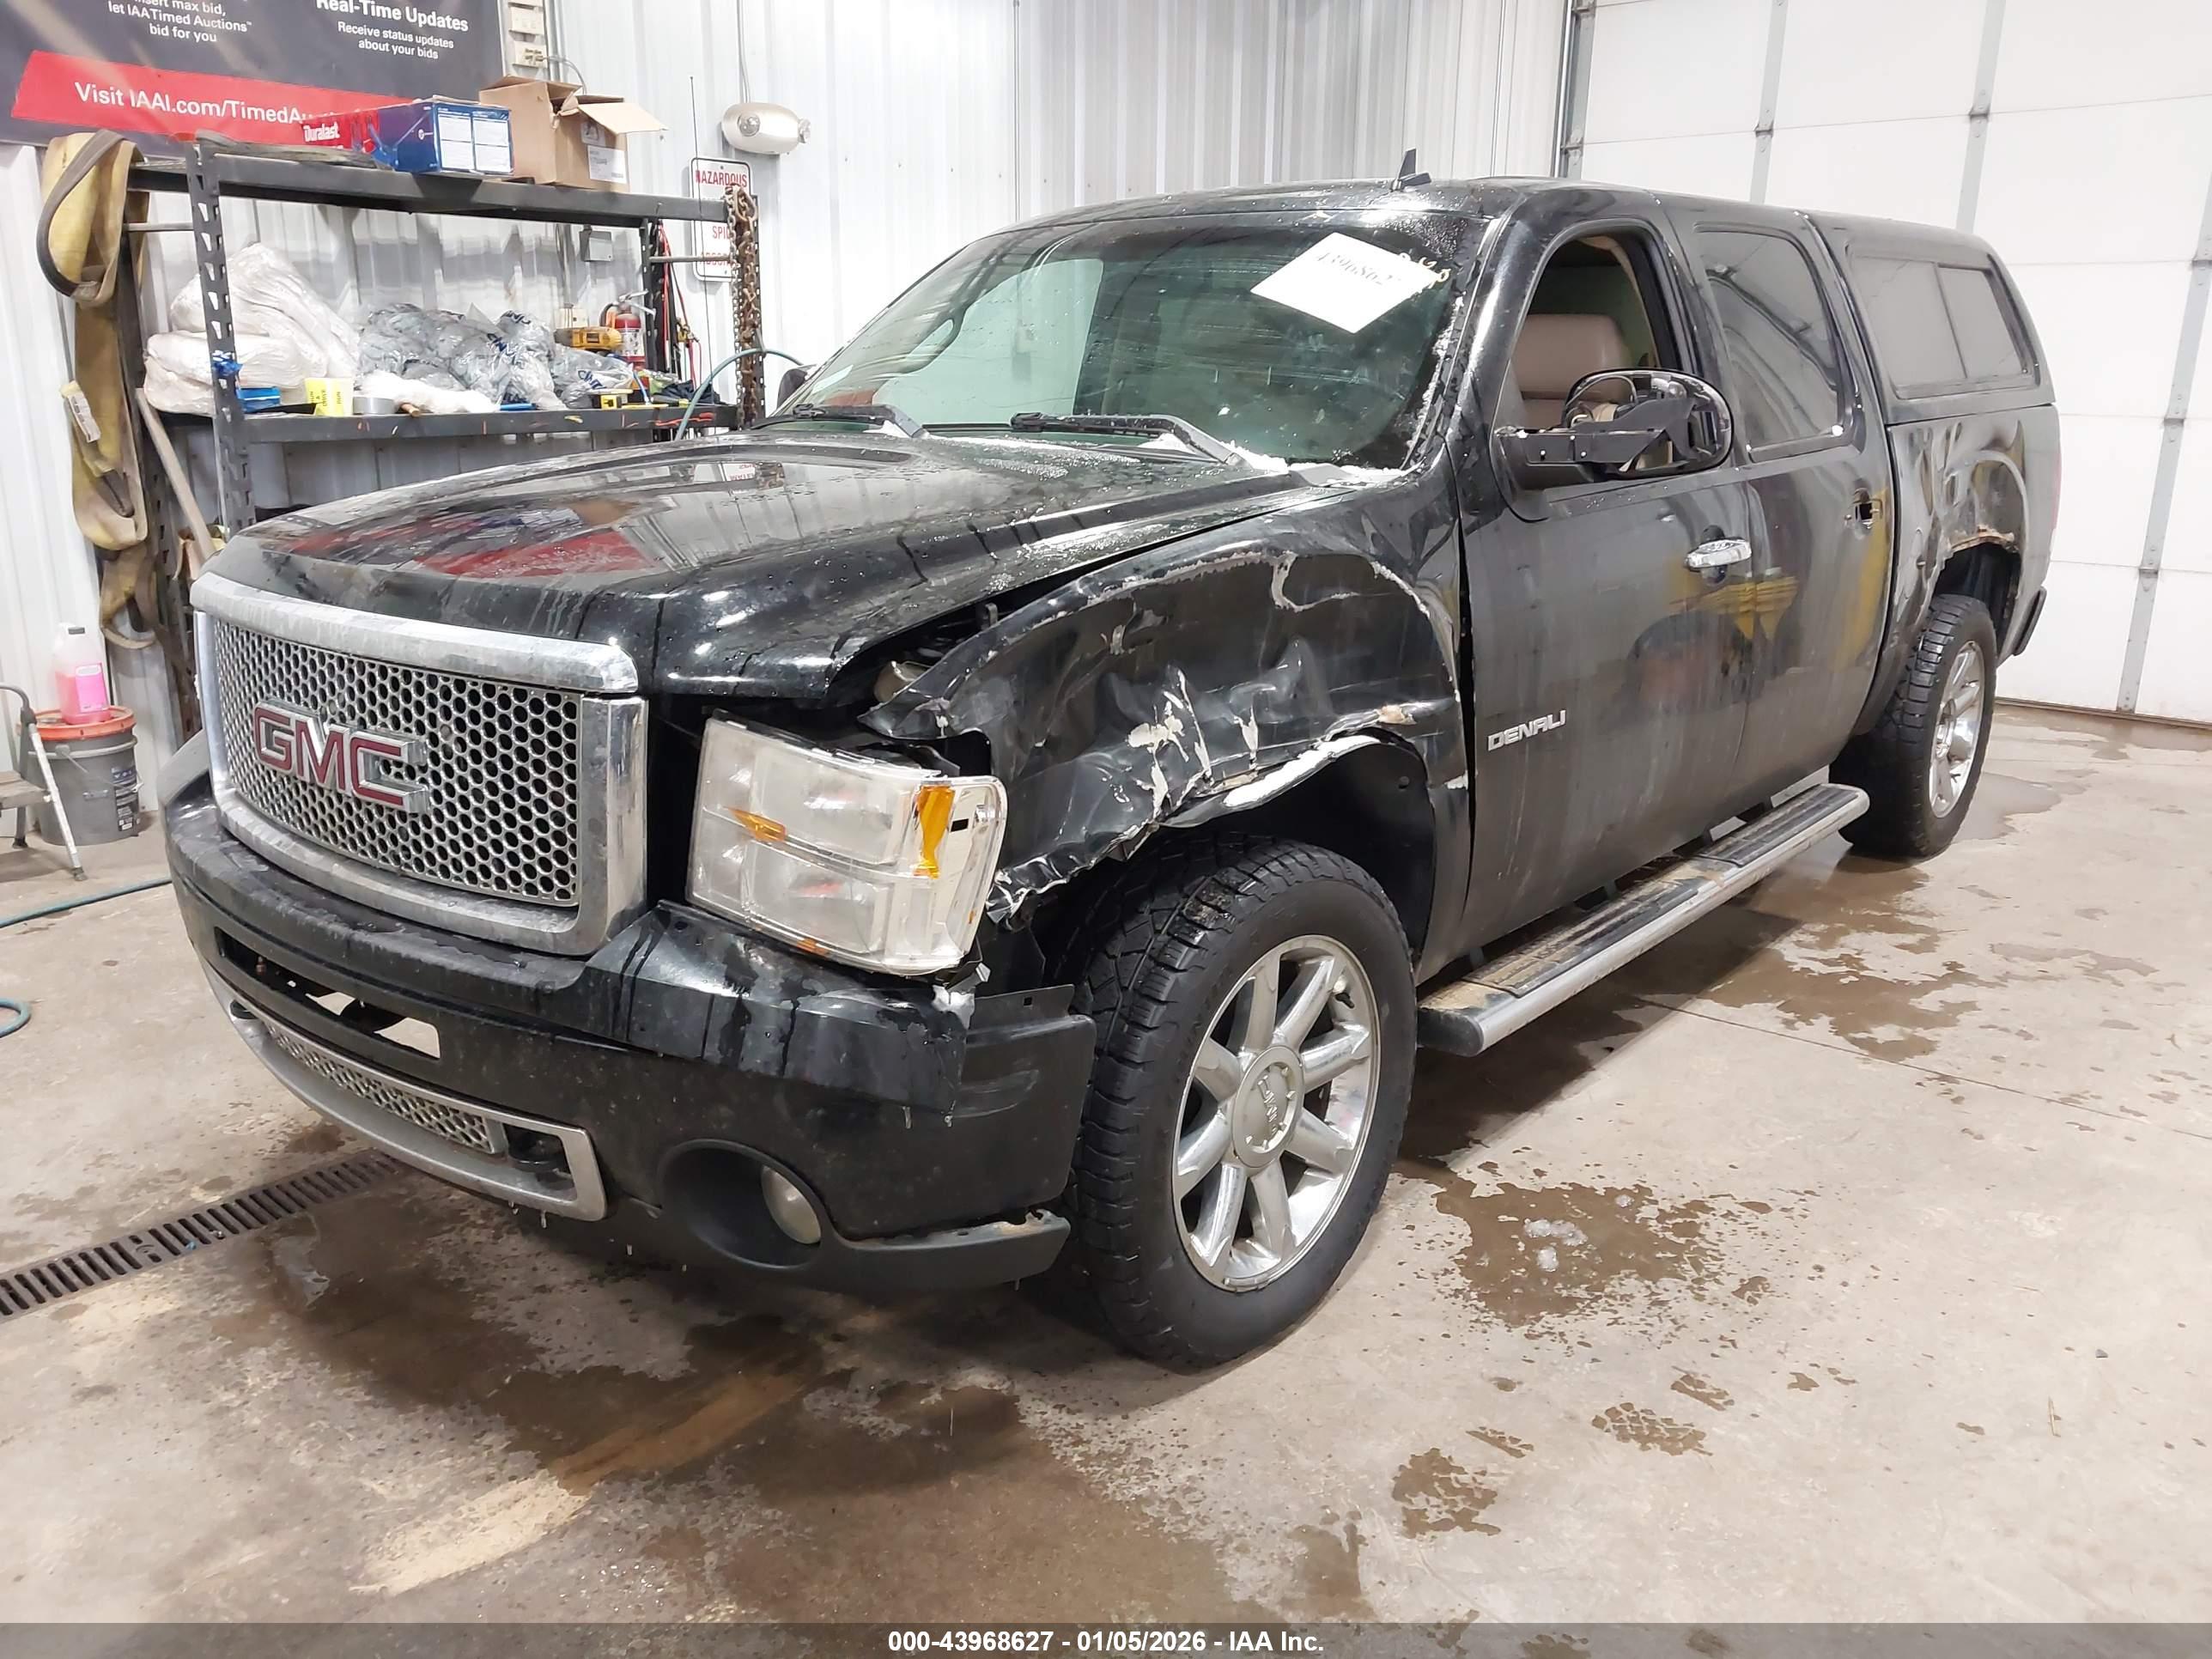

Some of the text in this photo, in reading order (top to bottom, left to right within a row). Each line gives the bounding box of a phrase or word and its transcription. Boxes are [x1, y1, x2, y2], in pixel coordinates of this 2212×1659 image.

[108, 1, 125, 15] let
[172, 0, 199, 11] max
[203, 2, 226, 16] bid,
[317, 0, 469, 32] Real-Time Updates
[149, 22, 217, 43] bid for you
[337, 21, 454, 49] Receive status updates
[358, 38, 439, 59] about your bids
[74, 82, 311, 124] Visit IAAI.com/TimedA
[695, 170, 748, 188] HAZARDOUS
[1487, 709, 1566, 751] DENALI
[253, 700, 429, 814] GMC
